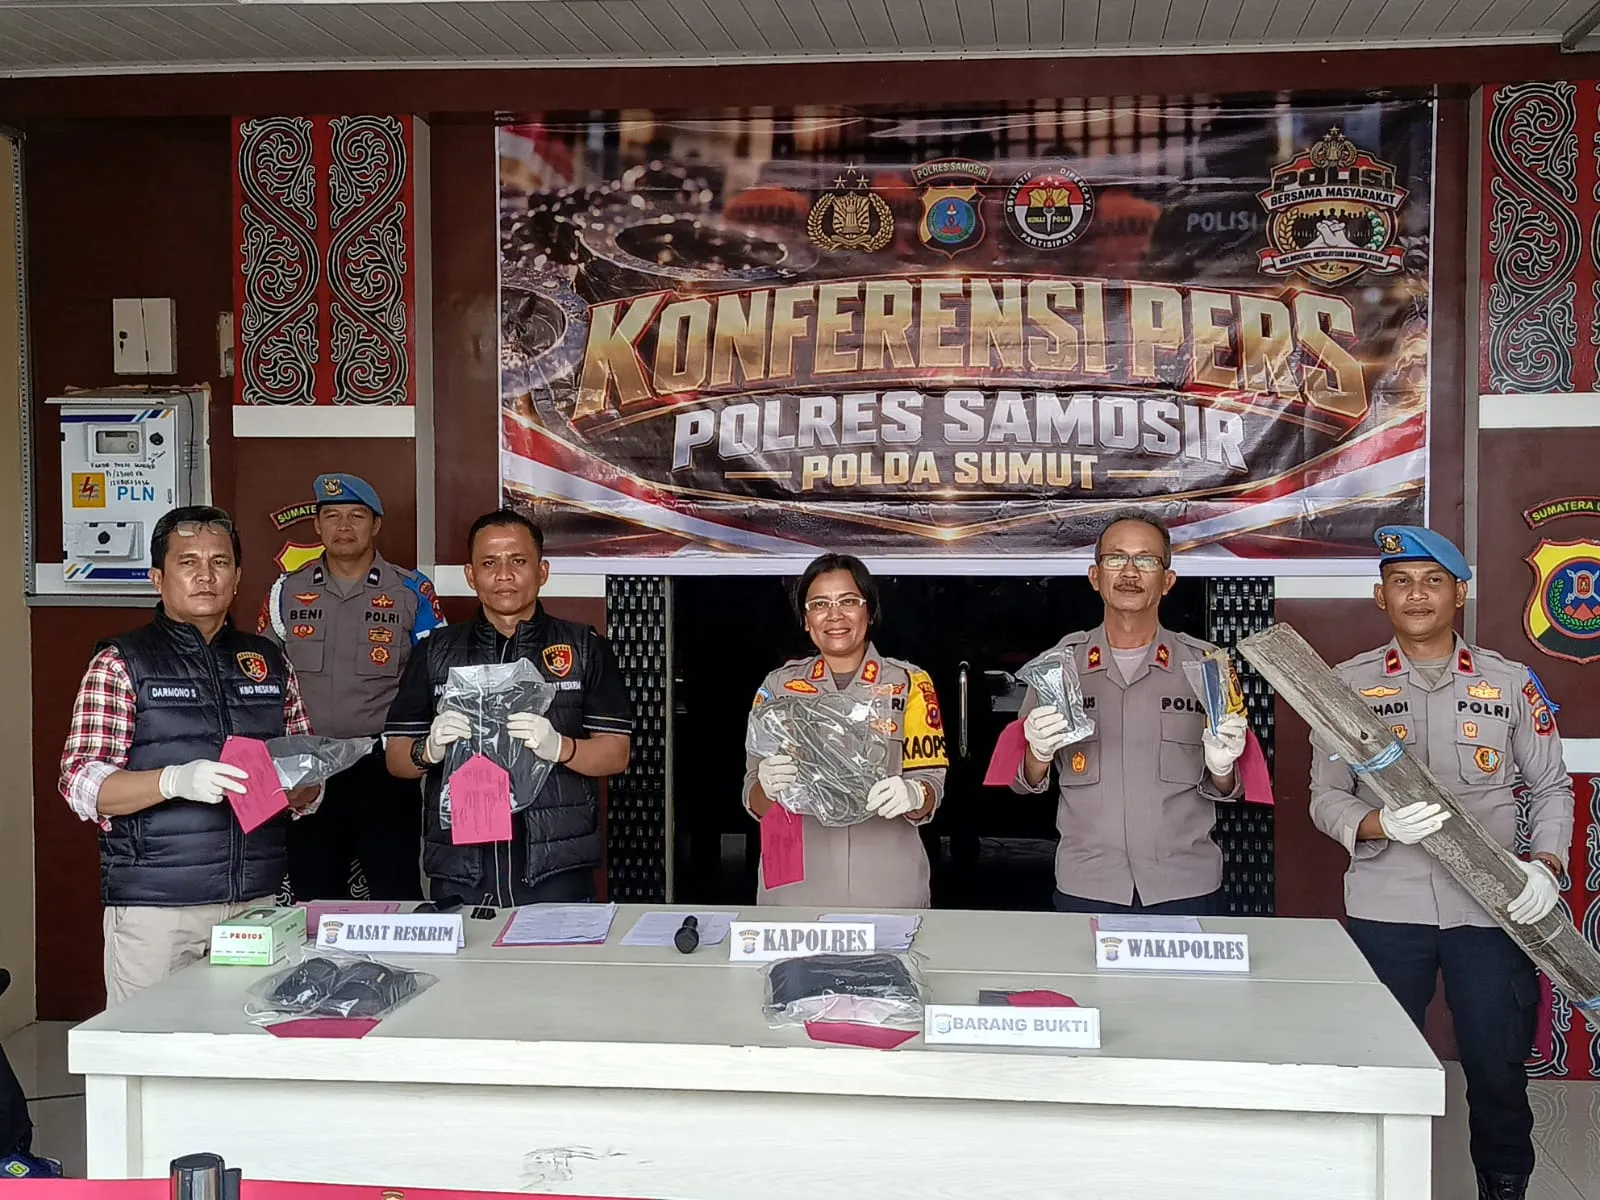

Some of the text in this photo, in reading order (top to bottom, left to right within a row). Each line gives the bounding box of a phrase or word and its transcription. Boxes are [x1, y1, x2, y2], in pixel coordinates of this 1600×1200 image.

[916, 161, 988, 179] POLRES SAMOSIR
[1273, 166, 1396, 193] POLISI
[1006, 171, 1033, 214] OBYEKTIF
[1059, 167, 1092, 212] DIPERCAYA
[1270, 187, 1396, 207] BERSAMA MASYARAKAT
[1052, 216, 1071, 224] POLRI
[1186, 210, 1258, 233] POLISI
[1020, 232, 1078, 248] PARTISIPASI
[571, 278, 1371, 426] KONFERENSI PERS
[671, 389, 1249, 472] POLRES SAMOSIR
[801, 453, 1100, 491] POLDA SUMUT
[117, 486, 155, 501] PLN
[277, 504, 317, 524] SUMATE
[1531, 500, 1594, 521] SUMATERA
[289, 609, 323, 621] BENI
[364, 611, 400, 625] POLRI
[1161, 697, 1206, 715] POLR
[1370, 701, 1409, 716] HADI
[1457, 700, 1510, 719] POLRI
[345, 924, 391, 941] KASAT
[393, 923, 455, 943] RESKRIM
[762, 928, 868, 953] KAPOLRES
[1127, 938, 1245, 961] WAKAPOLRES
[953, 1016, 1089, 1034] BARANG BUKTI
